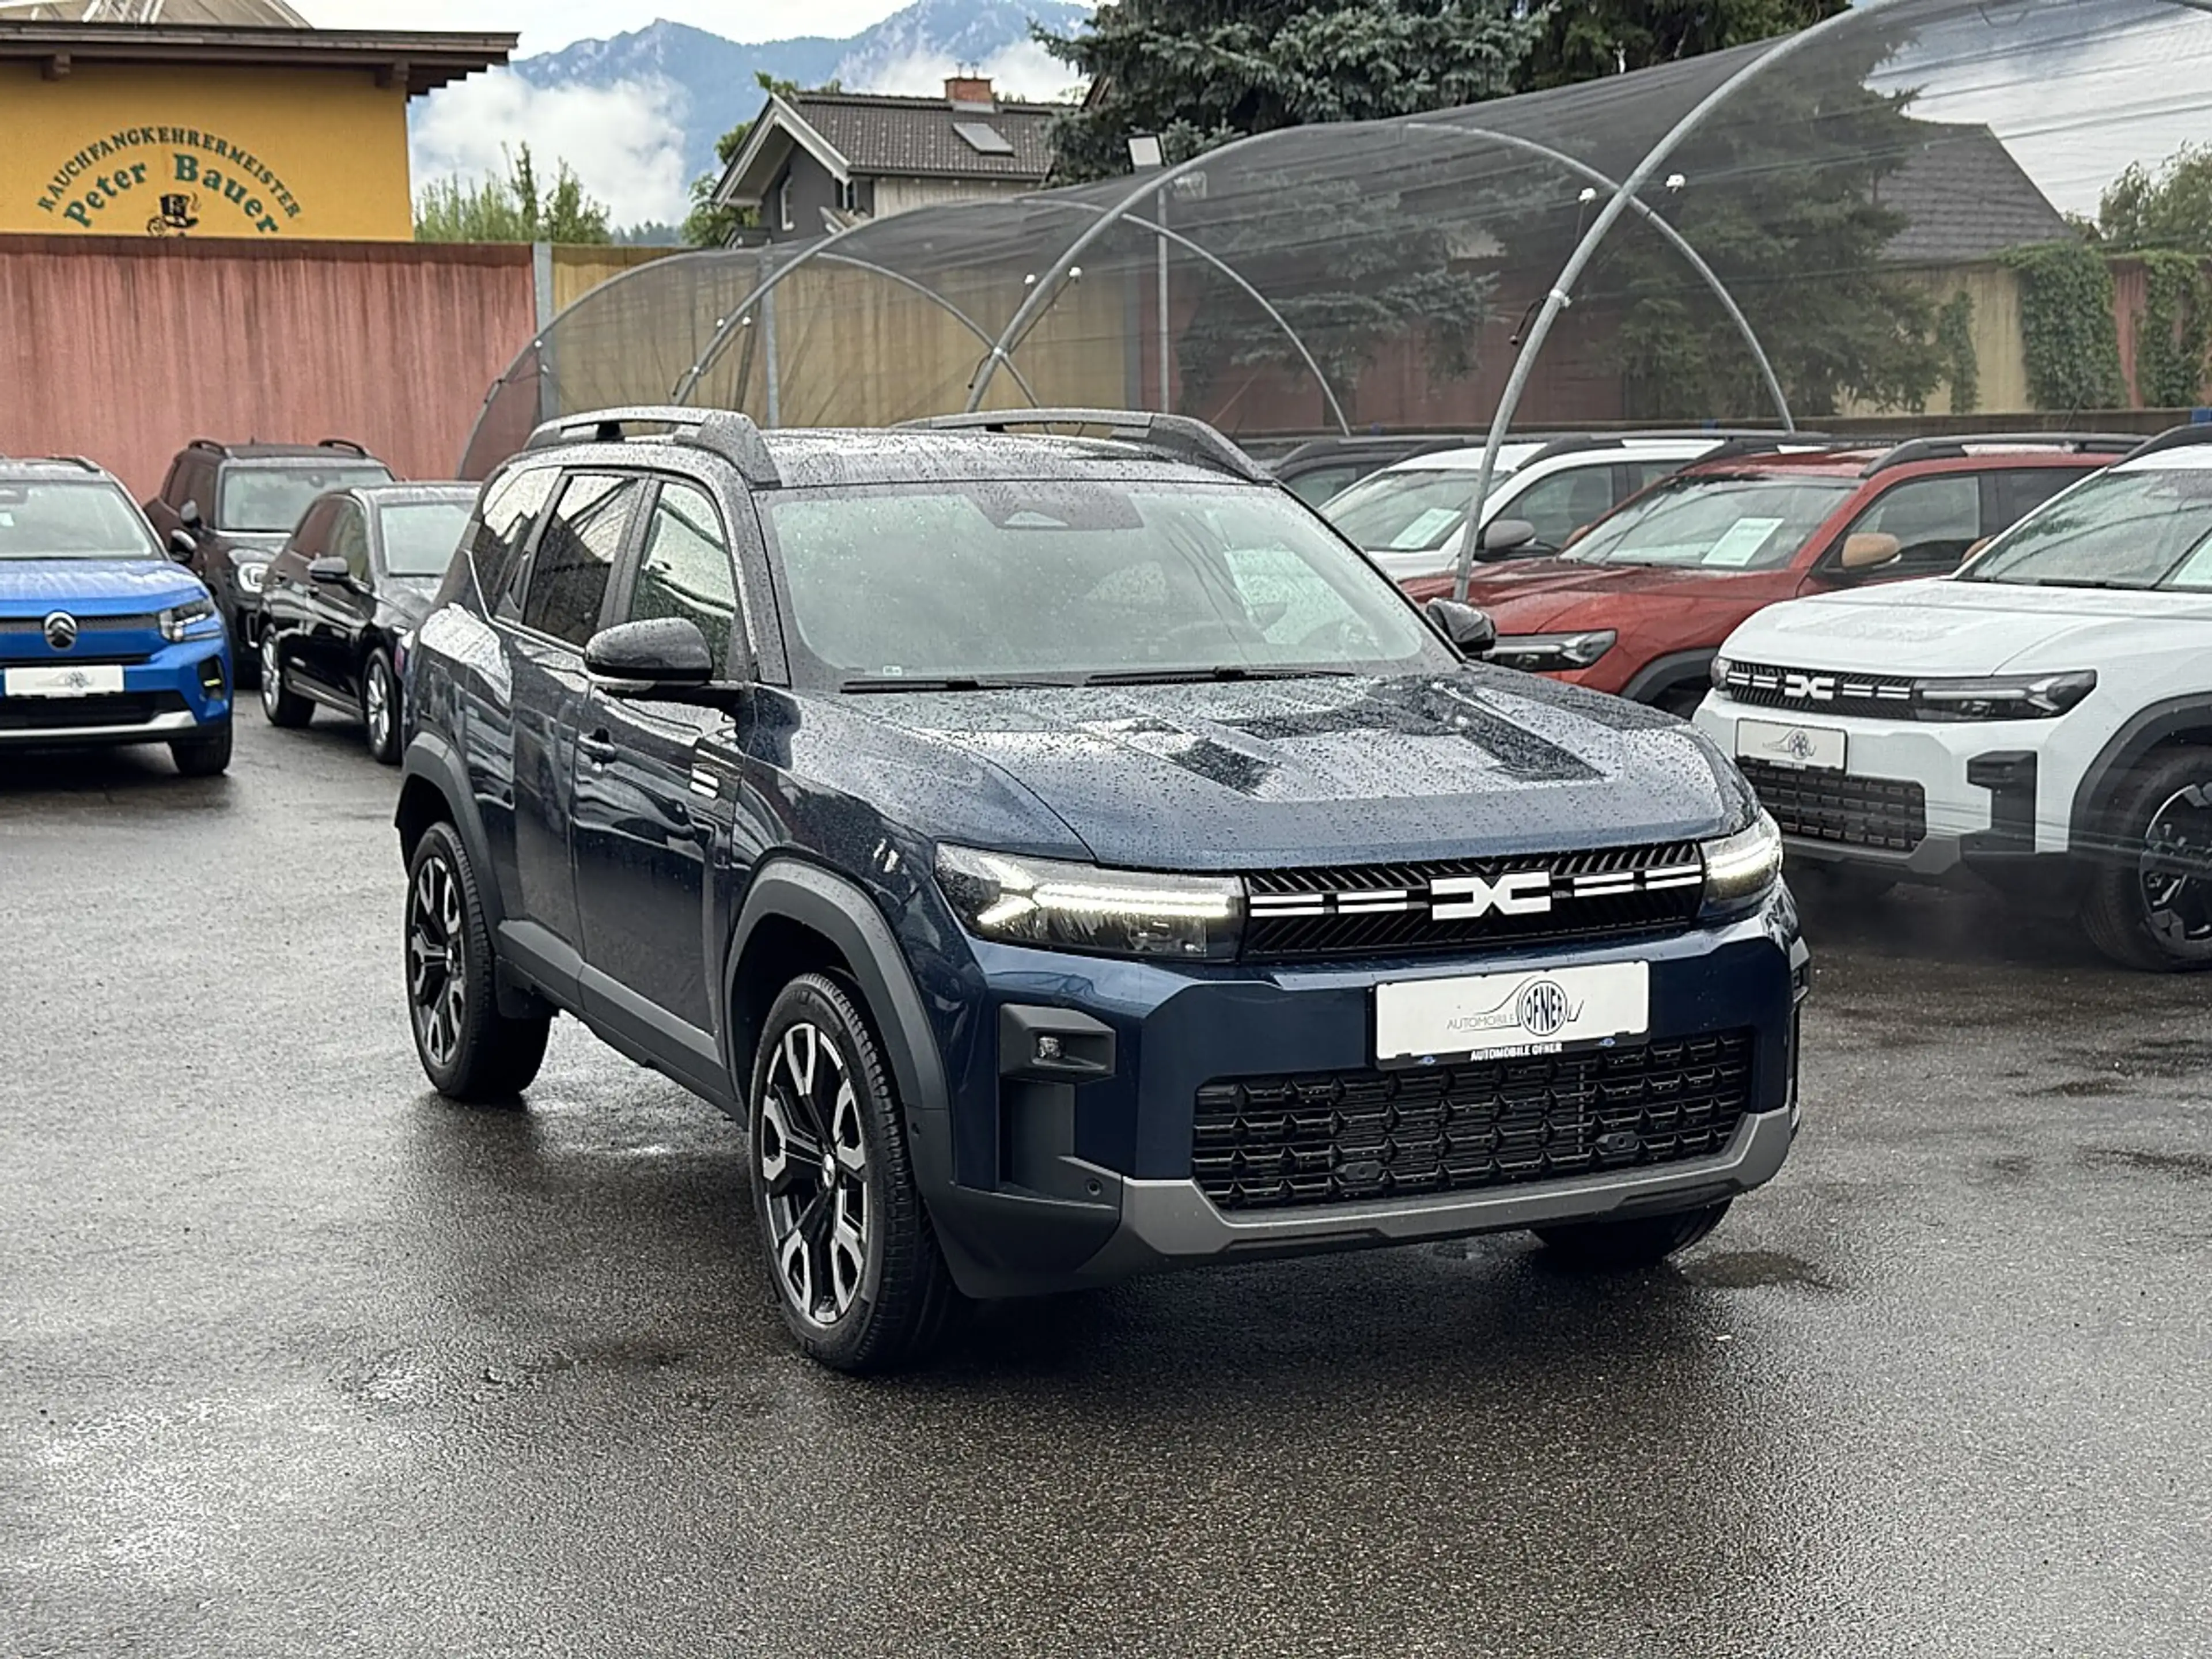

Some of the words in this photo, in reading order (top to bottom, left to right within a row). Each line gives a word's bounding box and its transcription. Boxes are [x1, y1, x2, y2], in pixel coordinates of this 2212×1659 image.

[63, 162, 147, 228] Peter
[173, 153, 279, 232] Bauer
[1447, 1013, 1514, 1030] AUTOMOBILE
[1471, 1044, 1531, 1062] AUTOMOBILE
